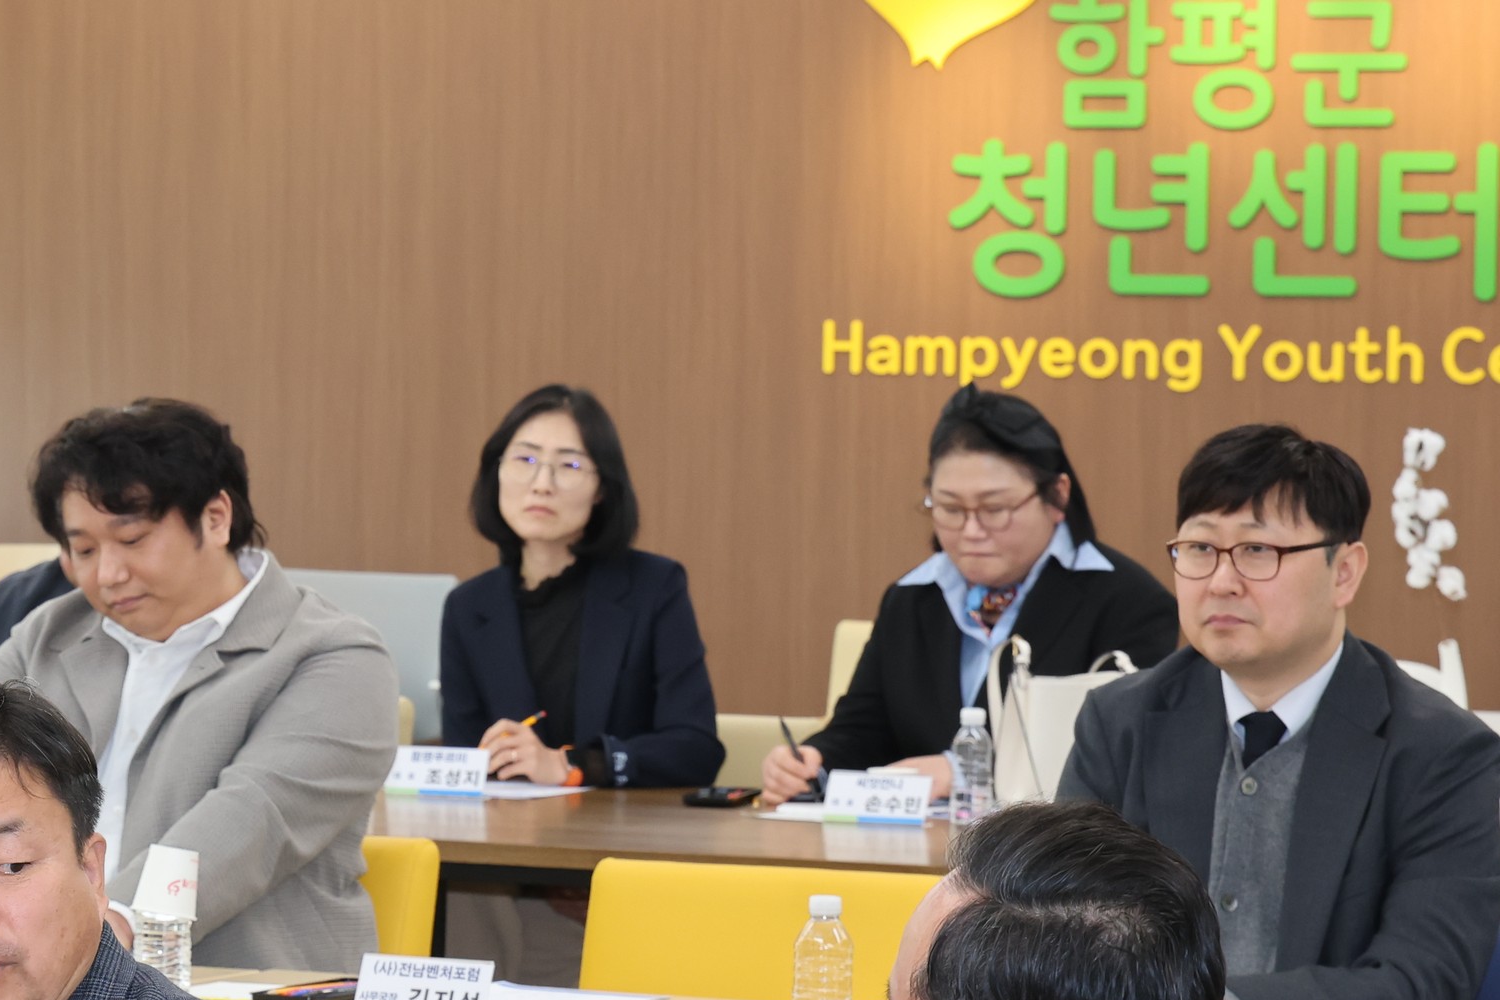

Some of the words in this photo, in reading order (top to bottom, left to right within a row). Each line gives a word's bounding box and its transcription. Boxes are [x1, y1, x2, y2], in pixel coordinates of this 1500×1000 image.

[1049, 0, 1408, 130] 함평군
[948, 138, 1500, 301] 청년센터
[821, 319, 1202, 392] Hampyeong
[1218, 323, 1424, 384] Youth
[865, 794, 923, 815] 손수민
[373, 960, 481, 983] (사)전남벤처포럼
